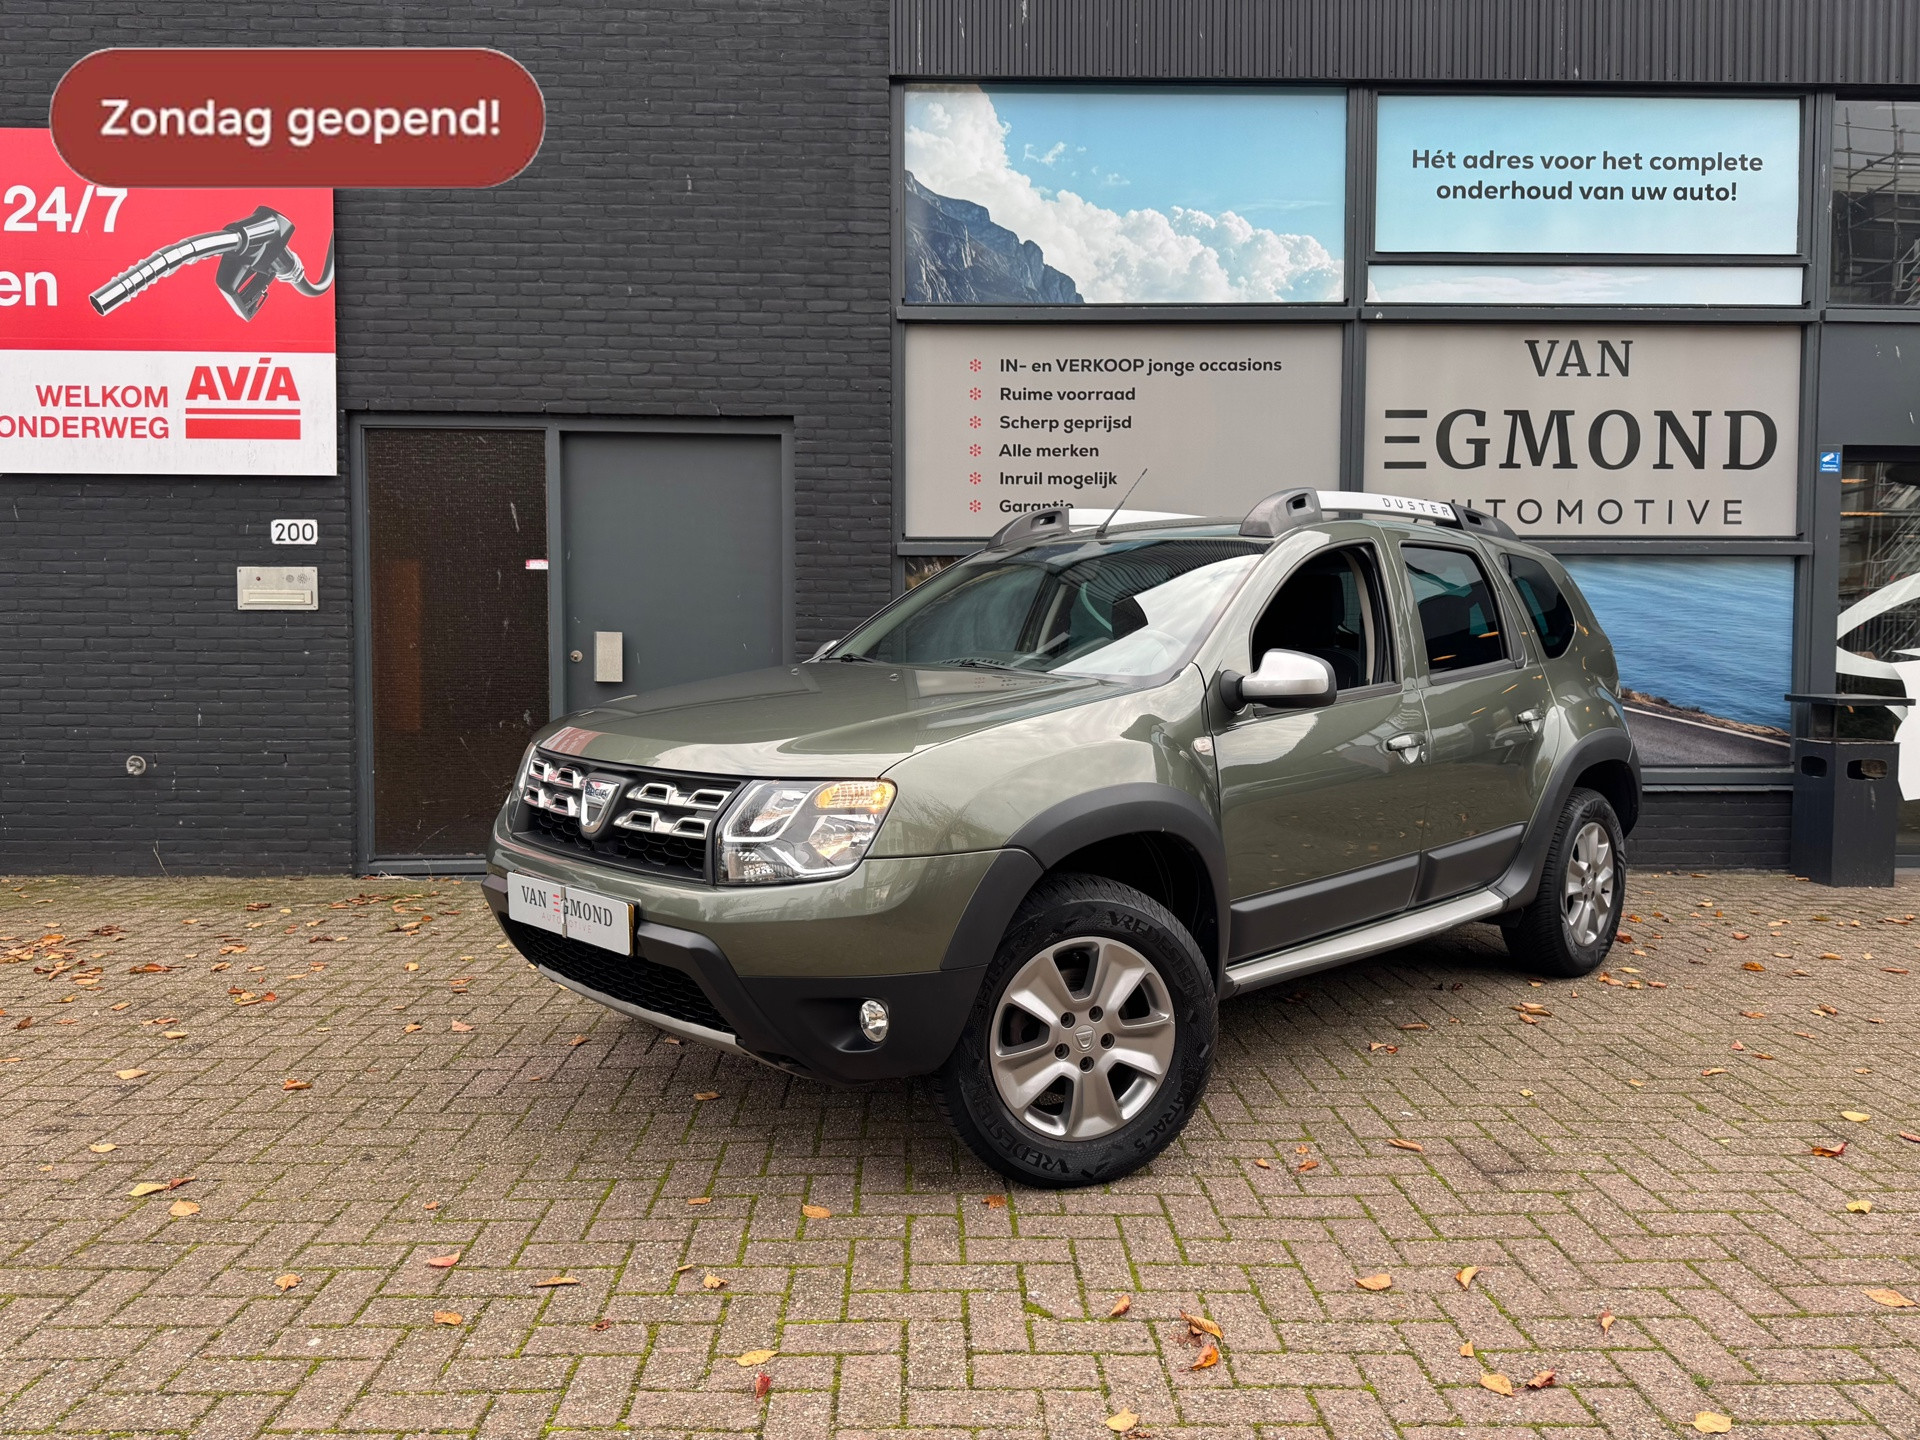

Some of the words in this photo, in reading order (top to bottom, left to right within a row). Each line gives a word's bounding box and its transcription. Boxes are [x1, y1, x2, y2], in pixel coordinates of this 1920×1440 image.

[1412, 149, 1456, 169] Hét
[1462, 149, 1535, 170] adres
[1539, 155, 1597, 170] voor
[1602, 150, 1643, 170] het
[1649, 152, 1764, 174] complete
[1436, 180, 1573, 200] onderhoud
[1578, 185, 1625, 200] van
[1631, 186, 1668, 201] uw
[1673, 182, 1738, 201] auto!
[3, 185, 128, 233] 24/7
[1000, 358, 1027, 372] IN-
[1031, 362, 1052, 373] en
[1056, 358, 1145, 373] VERKOOP
[1147, 358, 1195, 377] jonge
[1199, 357, 1282, 373] occasions
[1524, 339, 1634, 378] VAN
[35, 384, 169, 408] WELKOM
[1000, 387, 1053, 401] Ruime
[1057, 387, 1136, 401] voorraad
[0, 416, 169, 439] ONDERWEG
[999, 415, 1060, 433] Scherp
[1064, 415, 1132, 433] geprijsd
[999, 443, 1032, 457] Alle
[1036, 443, 1099, 457] merken
[1384, 408, 1778, 471] EGMOND
[1000, 471, 1043, 485] Inruil
[1047, 471, 1118, 489] mogelijk
[1382, 497, 1450, 517] DUSTER
[275, 523, 315, 542] 200
[521, 885, 547, 909] VAN
[541, 911, 592, 934] AUTOOTIVE
